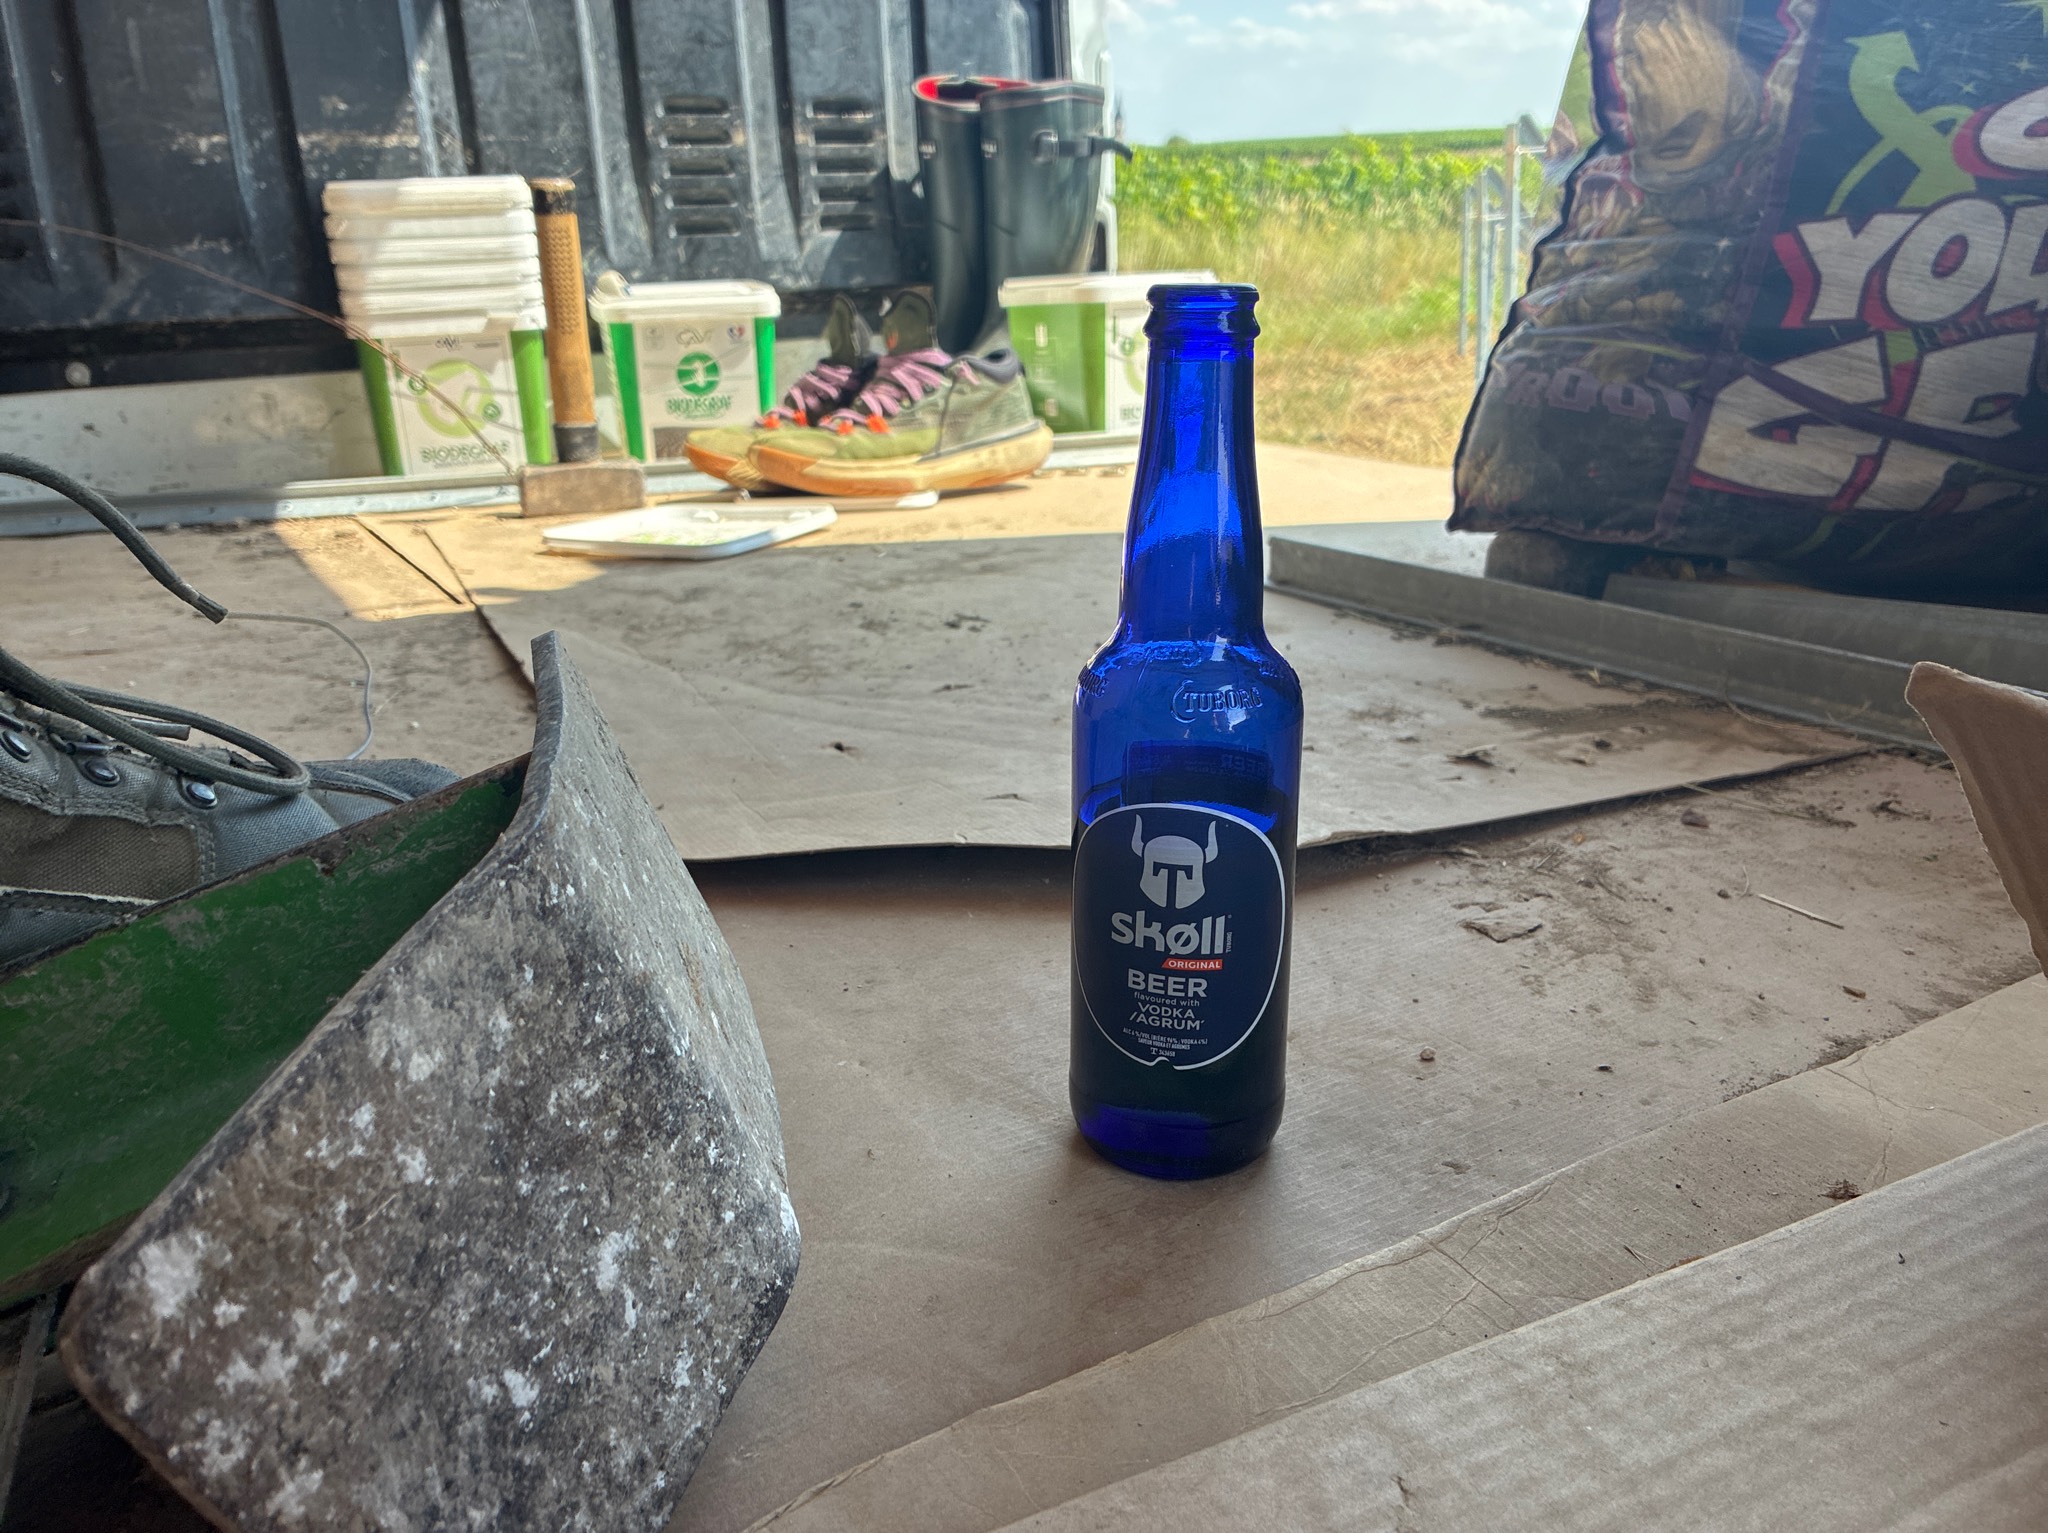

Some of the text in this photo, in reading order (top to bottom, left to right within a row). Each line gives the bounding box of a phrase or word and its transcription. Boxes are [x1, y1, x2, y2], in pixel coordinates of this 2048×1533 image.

[1168, 959, 1221, 969] ORIGINAL
[1127, 968, 1208, 998] BEER
[1134, 991, 1200, 1007] flavoured with
[1138, 1002, 1195, 1019] VODKA
